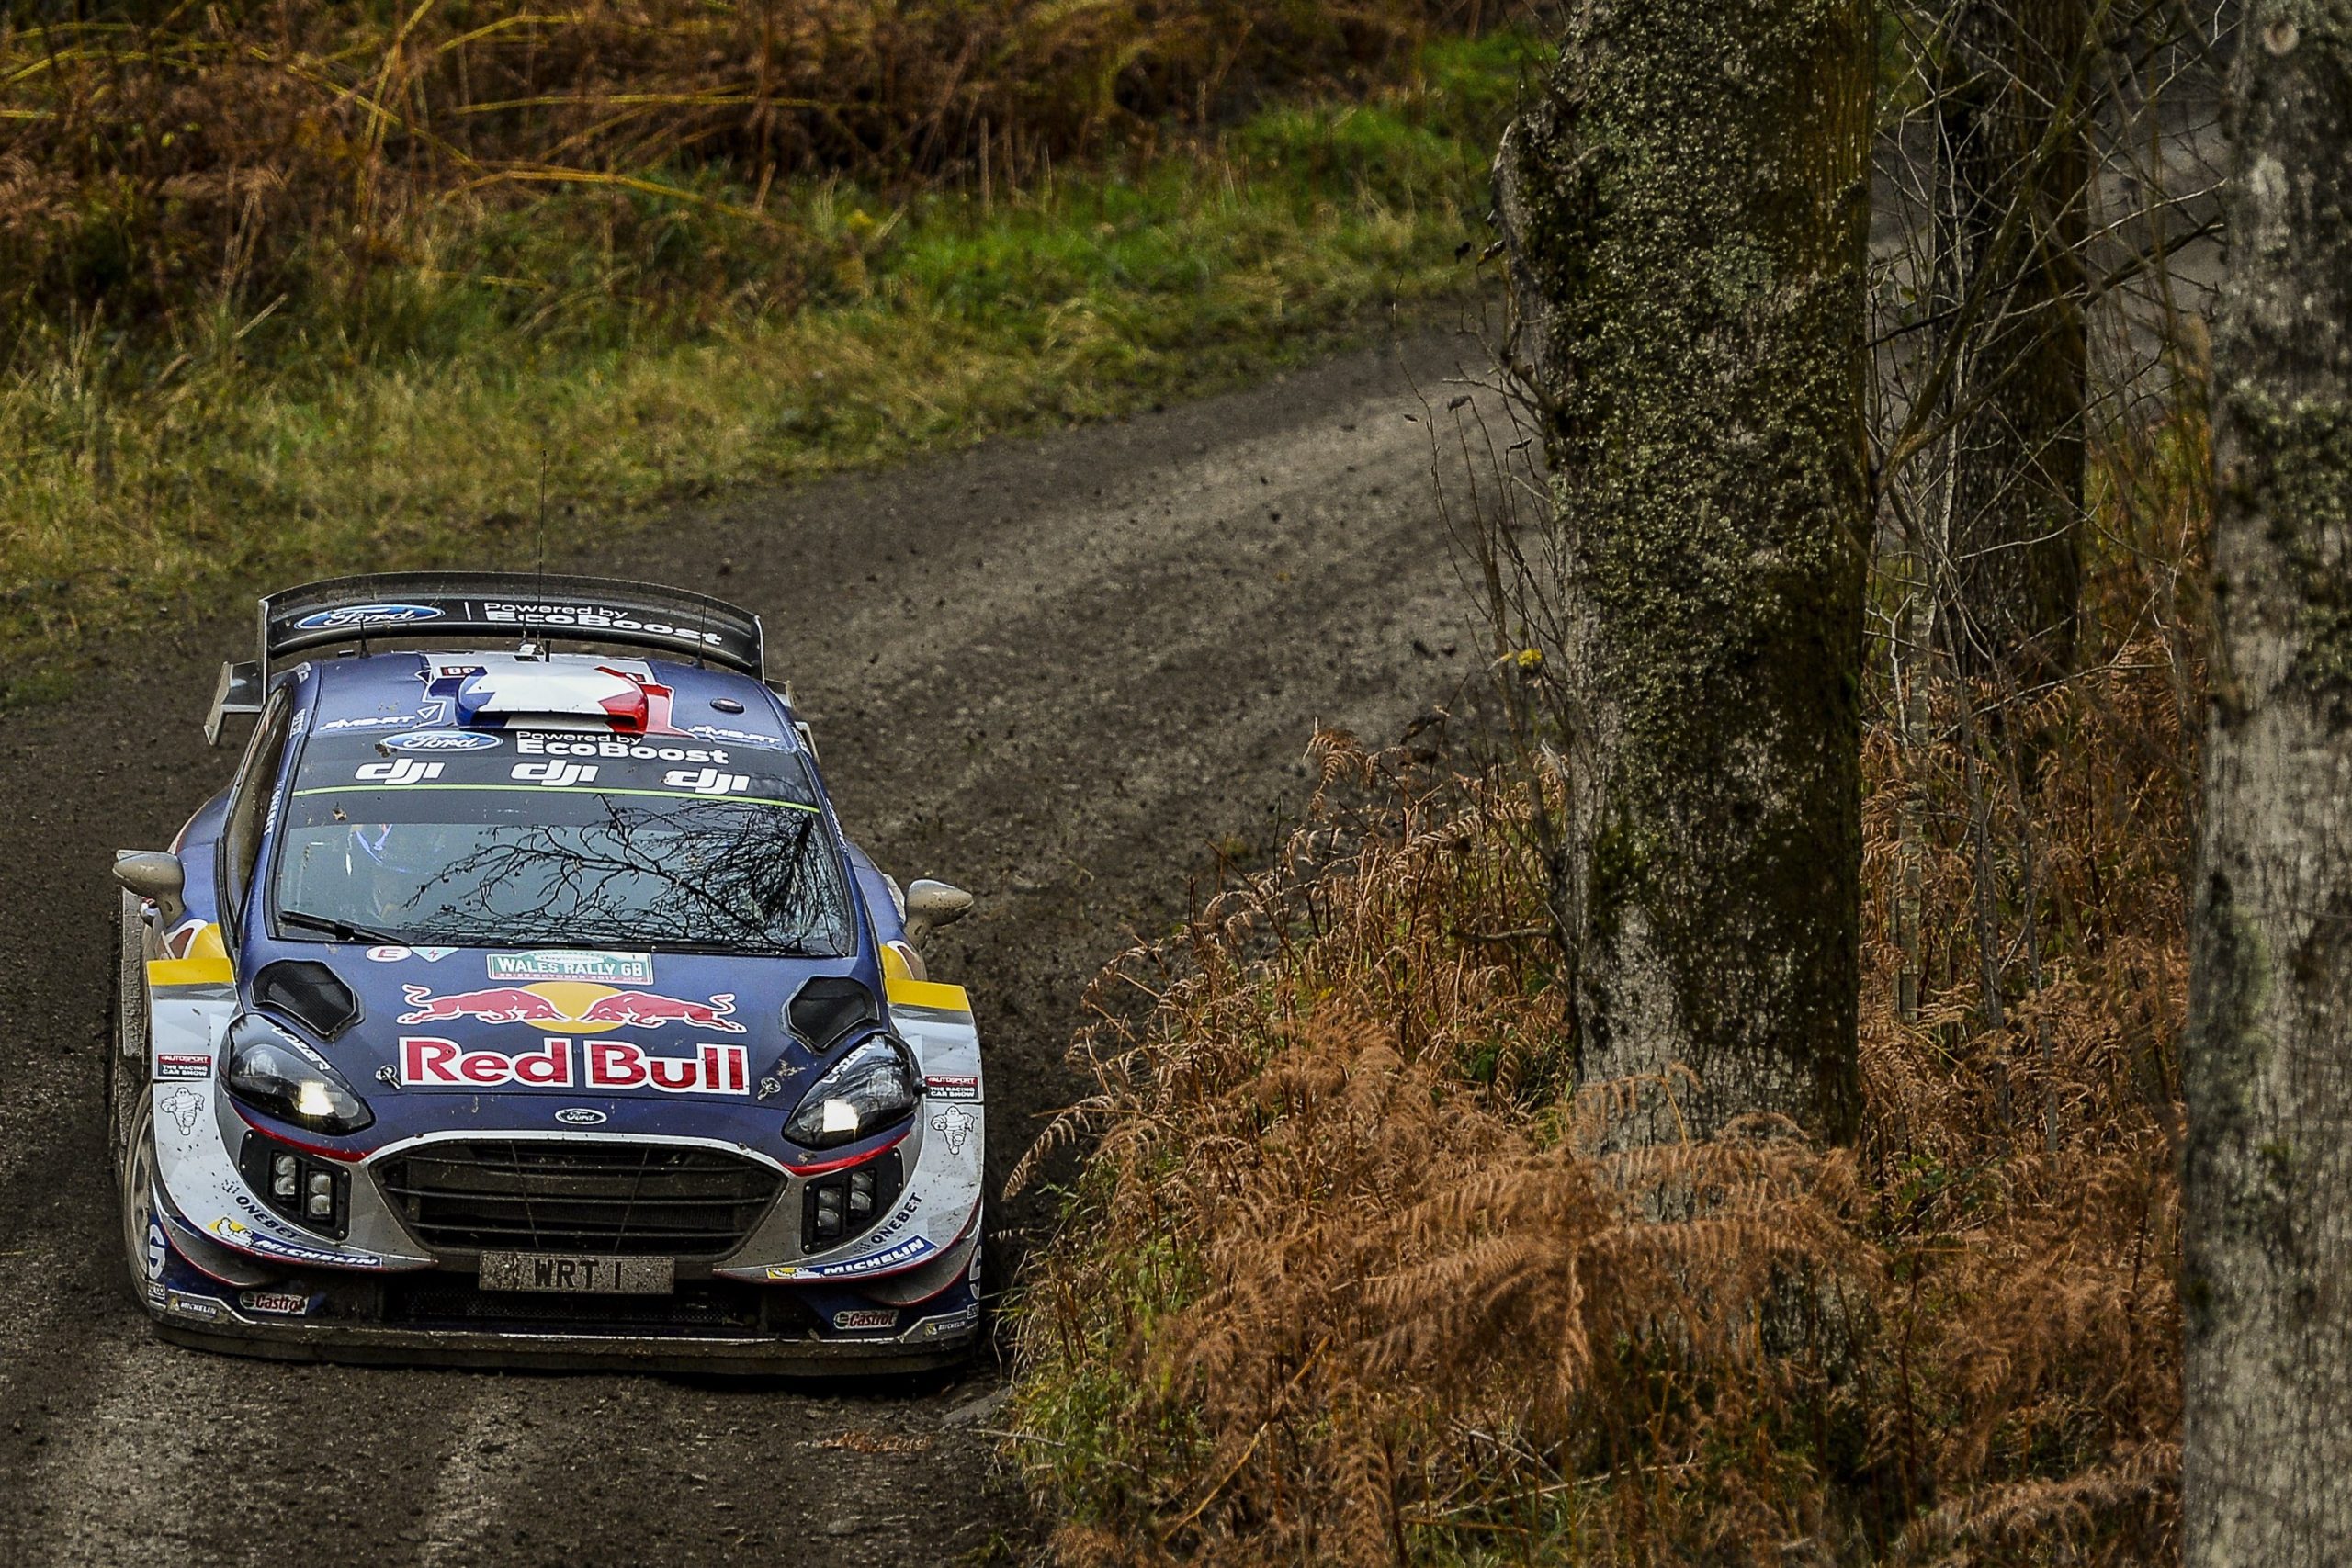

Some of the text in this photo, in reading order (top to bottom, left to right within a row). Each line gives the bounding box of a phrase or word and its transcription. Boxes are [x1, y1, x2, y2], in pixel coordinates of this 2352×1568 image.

[483, 602, 629, 619] Powered by
[485, 610, 723, 646] EcoBoost
[516, 730, 643, 746] Powered by
[516, 739, 729, 764] EcoBoost
[497, 956, 560, 974] WALES
[564, 962, 616, 976] RALLY
[621, 962, 643, 976] GB
[405, 1040, 745, 1090] Red Bull
[235, 1196, 301, 1239] ONEBET
[870, 1192, 922, 1245] ONEBET
[254, 1239, 379, 1266] MICHELIN
[824, 1238, 926, 1276] MICHELIN
[534, 1258, 599, 1290] WRT
[180, 1301, 217, 1315] MICHELIN
[850, 1313, 895, 1326] Castrol
[938, 1320, 966, 1331] MICHELIN
